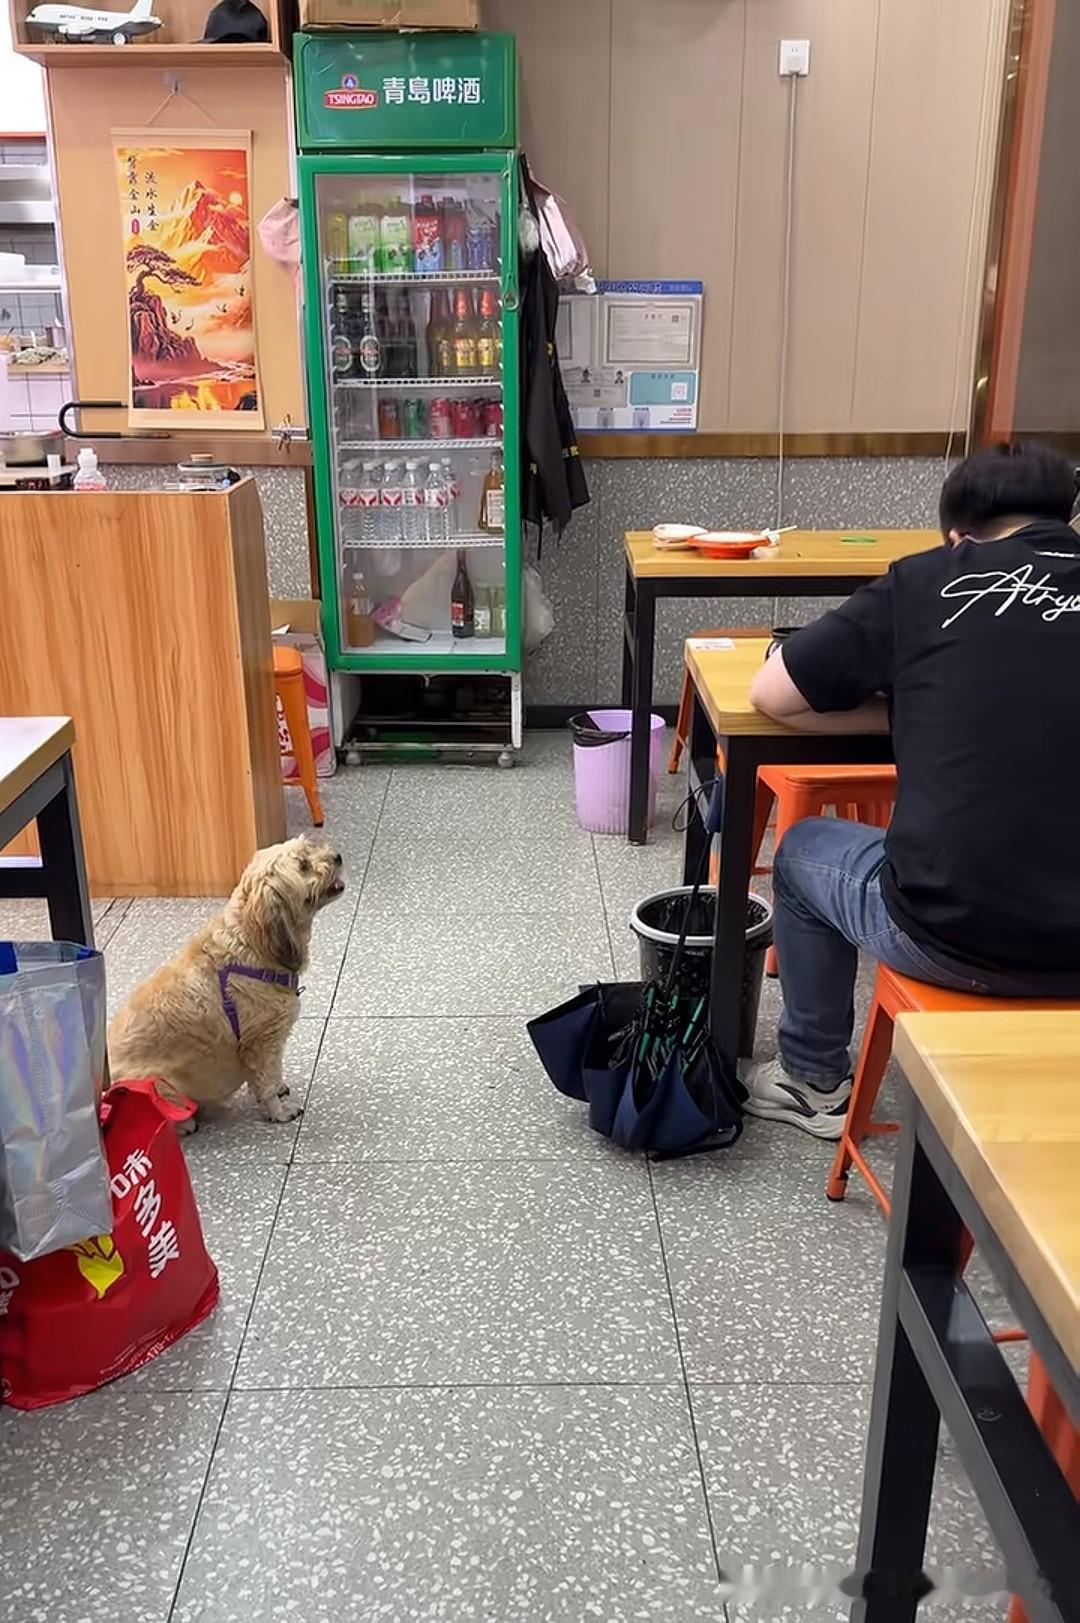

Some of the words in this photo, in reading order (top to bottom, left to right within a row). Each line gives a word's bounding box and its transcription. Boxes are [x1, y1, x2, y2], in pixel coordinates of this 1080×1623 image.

[327, 93, 375, 105] TSINGTAO
[383, 78, 481, 105] 青島啤酒
[111, 1149, 180, 1279] 味多美
